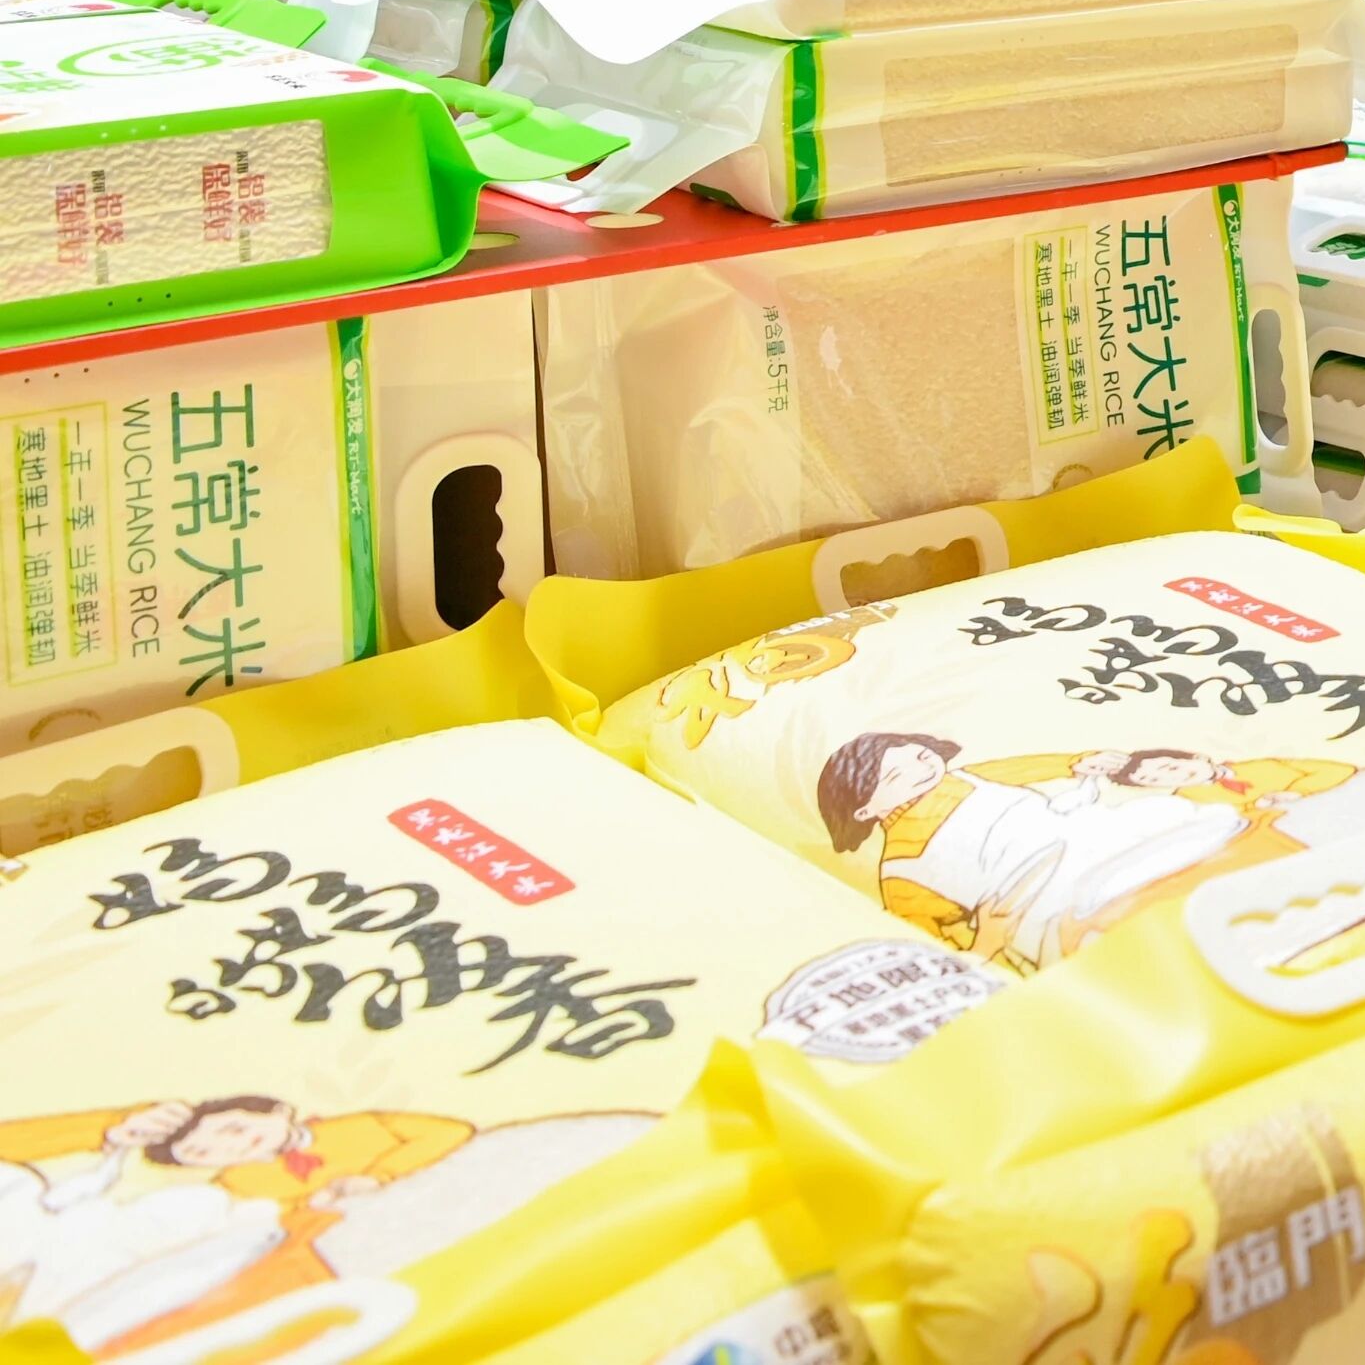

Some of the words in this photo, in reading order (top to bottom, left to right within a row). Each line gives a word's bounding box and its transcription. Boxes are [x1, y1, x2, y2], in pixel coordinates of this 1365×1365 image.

[1034, 241, 1055, 330] 寒地黑土
[1061, 239, 1081, 325] 一年一季
[1095, 224, 1116, 363] WUCHANG
[1066, 335, 1088, 423] 当季鲜米
[1120, 215, 1194, 460] 五常大米
[345, 380, 364, 438] 大润发
[1040, 339, 1065, 428] 油润弹韧
[1104, 368, 1124, 427] RICE
[16, 426, 50, 539] 寒地黑土
[121, 397, 158, 573] WUCHANG
[348, 441, 363, 515] RT-Mart
[170, 382, 267, 697] 五常大米
[23, 551, 57, 665] 油润弹韧
[68, 545, 103, 655] 当季鲜米
[129, 587, 160, 659] RICE
